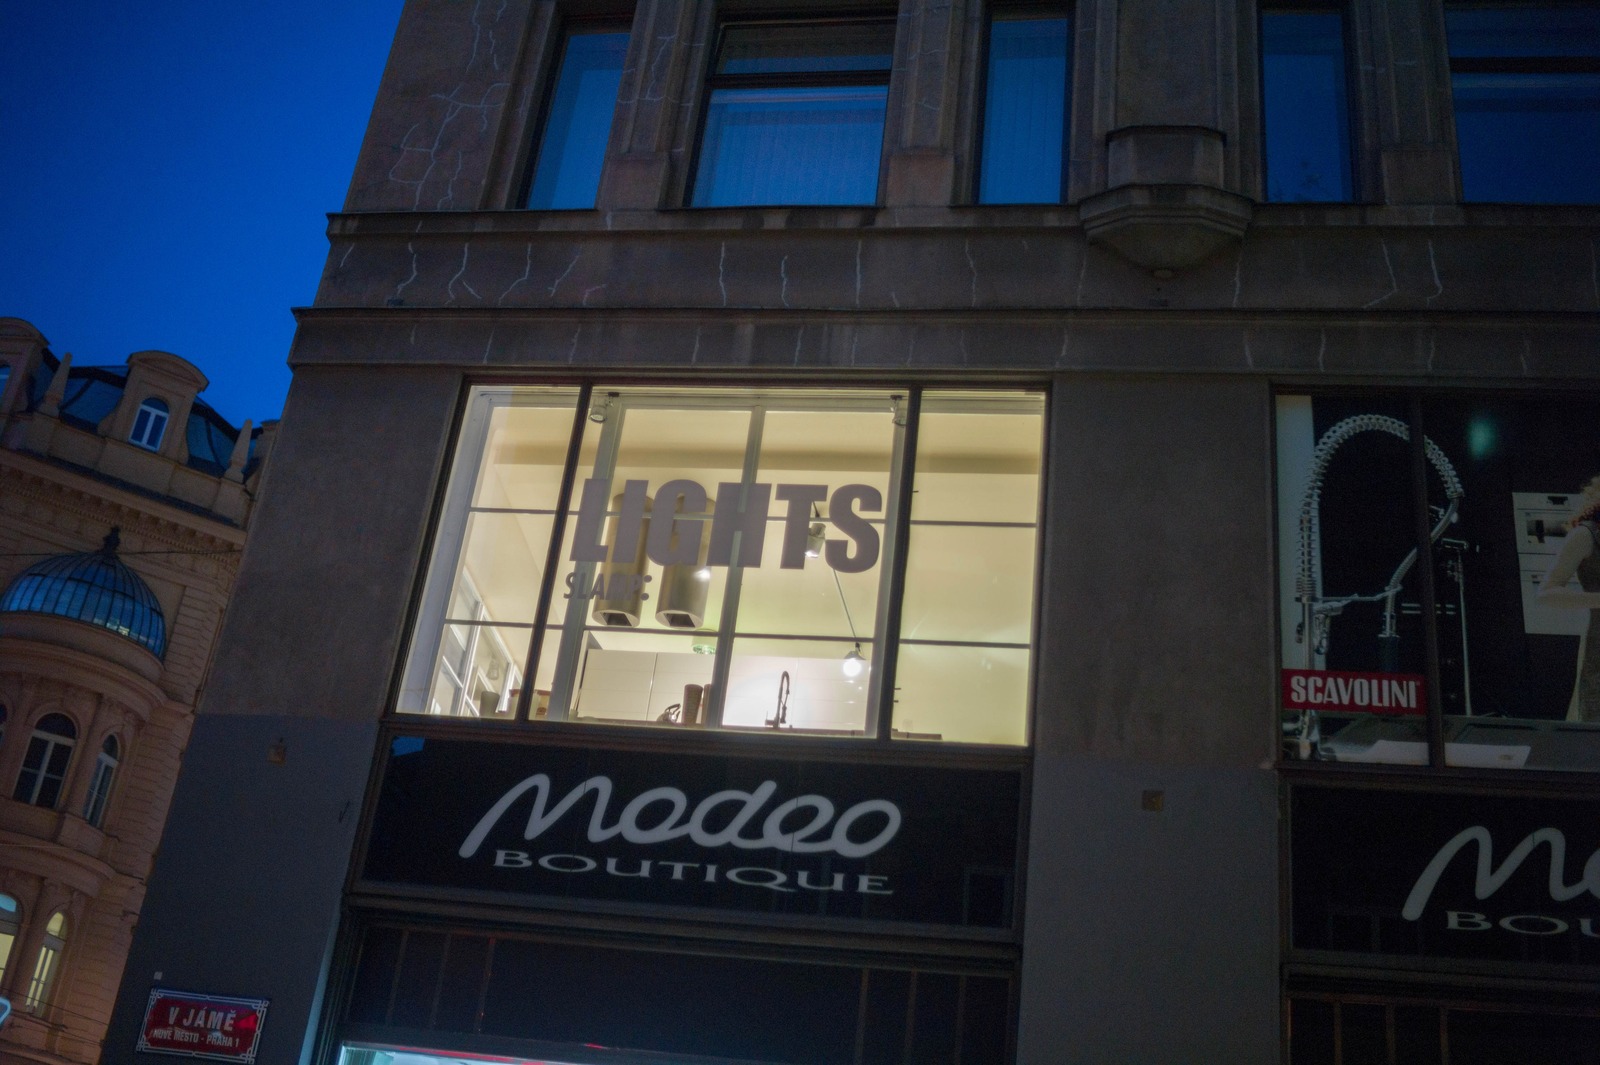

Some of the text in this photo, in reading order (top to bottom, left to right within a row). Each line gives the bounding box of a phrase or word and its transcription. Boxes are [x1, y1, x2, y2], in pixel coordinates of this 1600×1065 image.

[569, 478, 883, 574] LIGHTS
[1290, 674, 1418, 709] SCAVOLINI
[458, 773, 902, 859] Modeo
[493, 849, 895, 895] BOUTIQUE
[1401, 825, 1600, 922] M
[168, 1006, 237, 1032] V JÁMĚ
[206, 1033, 233, 1047] PRAHA
[235, 1037, 240, 1048] 1
